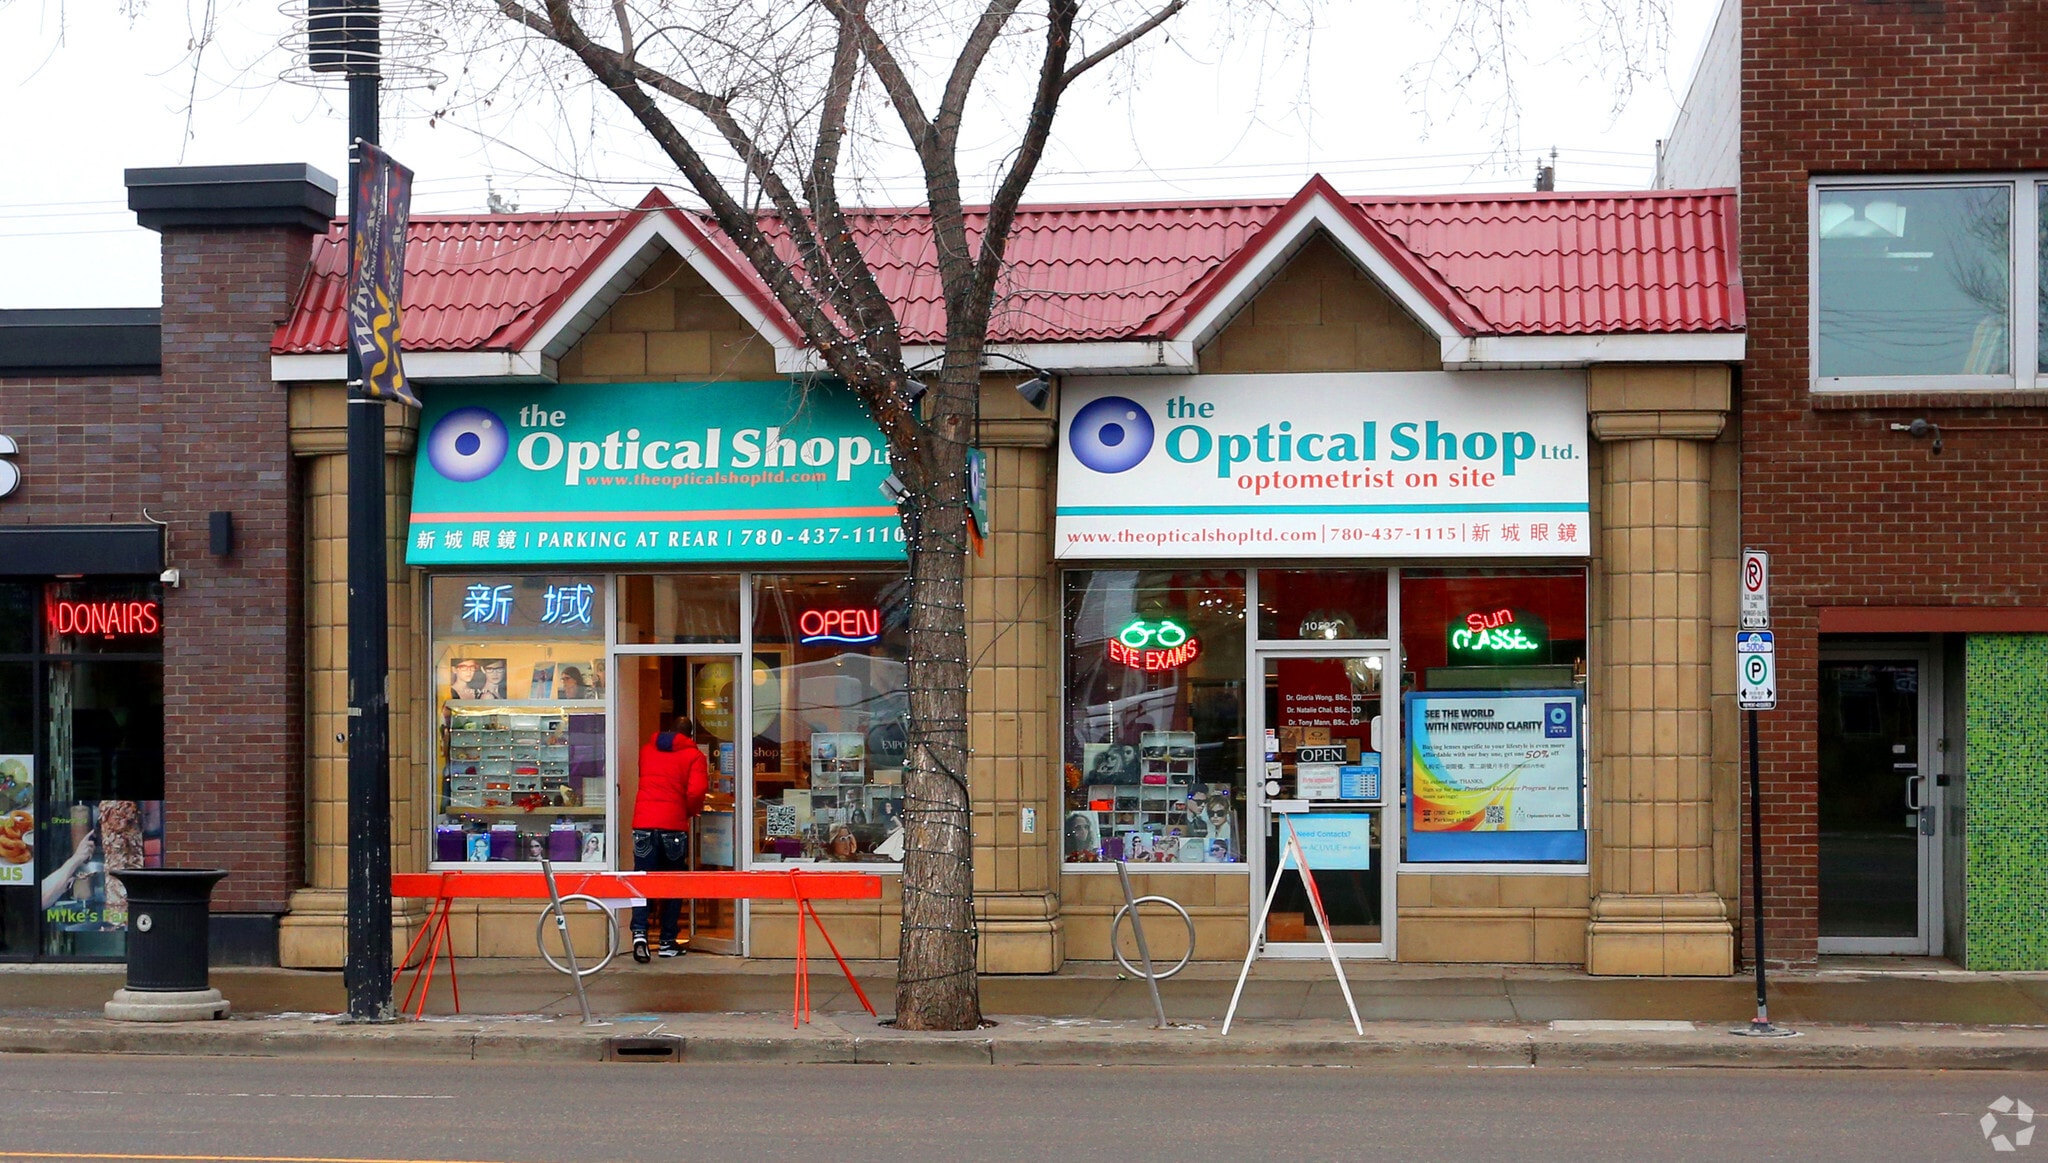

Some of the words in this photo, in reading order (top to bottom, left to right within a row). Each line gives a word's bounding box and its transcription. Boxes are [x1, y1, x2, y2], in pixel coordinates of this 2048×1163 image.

[351, 244, 376, 355] Whyte
[519, 403, 566, 427] the
[1166, 396, 1215, 419] the
[516, 428, 722, 486] Optical
[731, 427, 875, 482] Shop
[873, 446, 892, 465] Lt
[1164, 421, 1378, 479] Optical
[1390, 420, 1537, 477] Shop
[1540, 443, 1580, 461] Ltd.
[585, 471, 828, 489] www.theopticalshopltd.com
[1237, 467, 1394, 495] optometrist
[1405, 471, 1439, 488] on
[1448, 467, 1496, 488] site
[416, 529, 518, 550] 新城眼鏡
[537, 531, 627, 549] PARKING
[635, 531, 659, 548] AT
[668, 530, 719, 548] REAR
[740, 526, 905, 547] 780-437-1110
[1066, 524, 1318, 546] www.theopticalshopltd.com
[1330, 522, 1457, 542] 780-437-1115
[1471, 522, 1579, 544] 新城眼鏡
[462, 583, 594, 626] 新城
[58, 601, 158, 635] DONAIRS
[800, 609, 879, 636] OPEN
[1467, 609, 1514, 633] Sun
[1110, 639, 1141, 669] EYE
[1145, 638, 1197, 671] EXAMS
[1424, 709, 1441, 718] SEE
[1442, 709, 1460, 718] THE
[1461, 709, 1494, 718] WORLD
[1425, 722, 1450, 732] WITH
[1451, 721, 1504, 731] NEWFOUND
[1506, 720, 1543, 730] CLARITY
[753, 747, 779, 759] shop
[1300, 749, 1343, 762] OPEN
[1525, 750, 1550, 758] 50%
